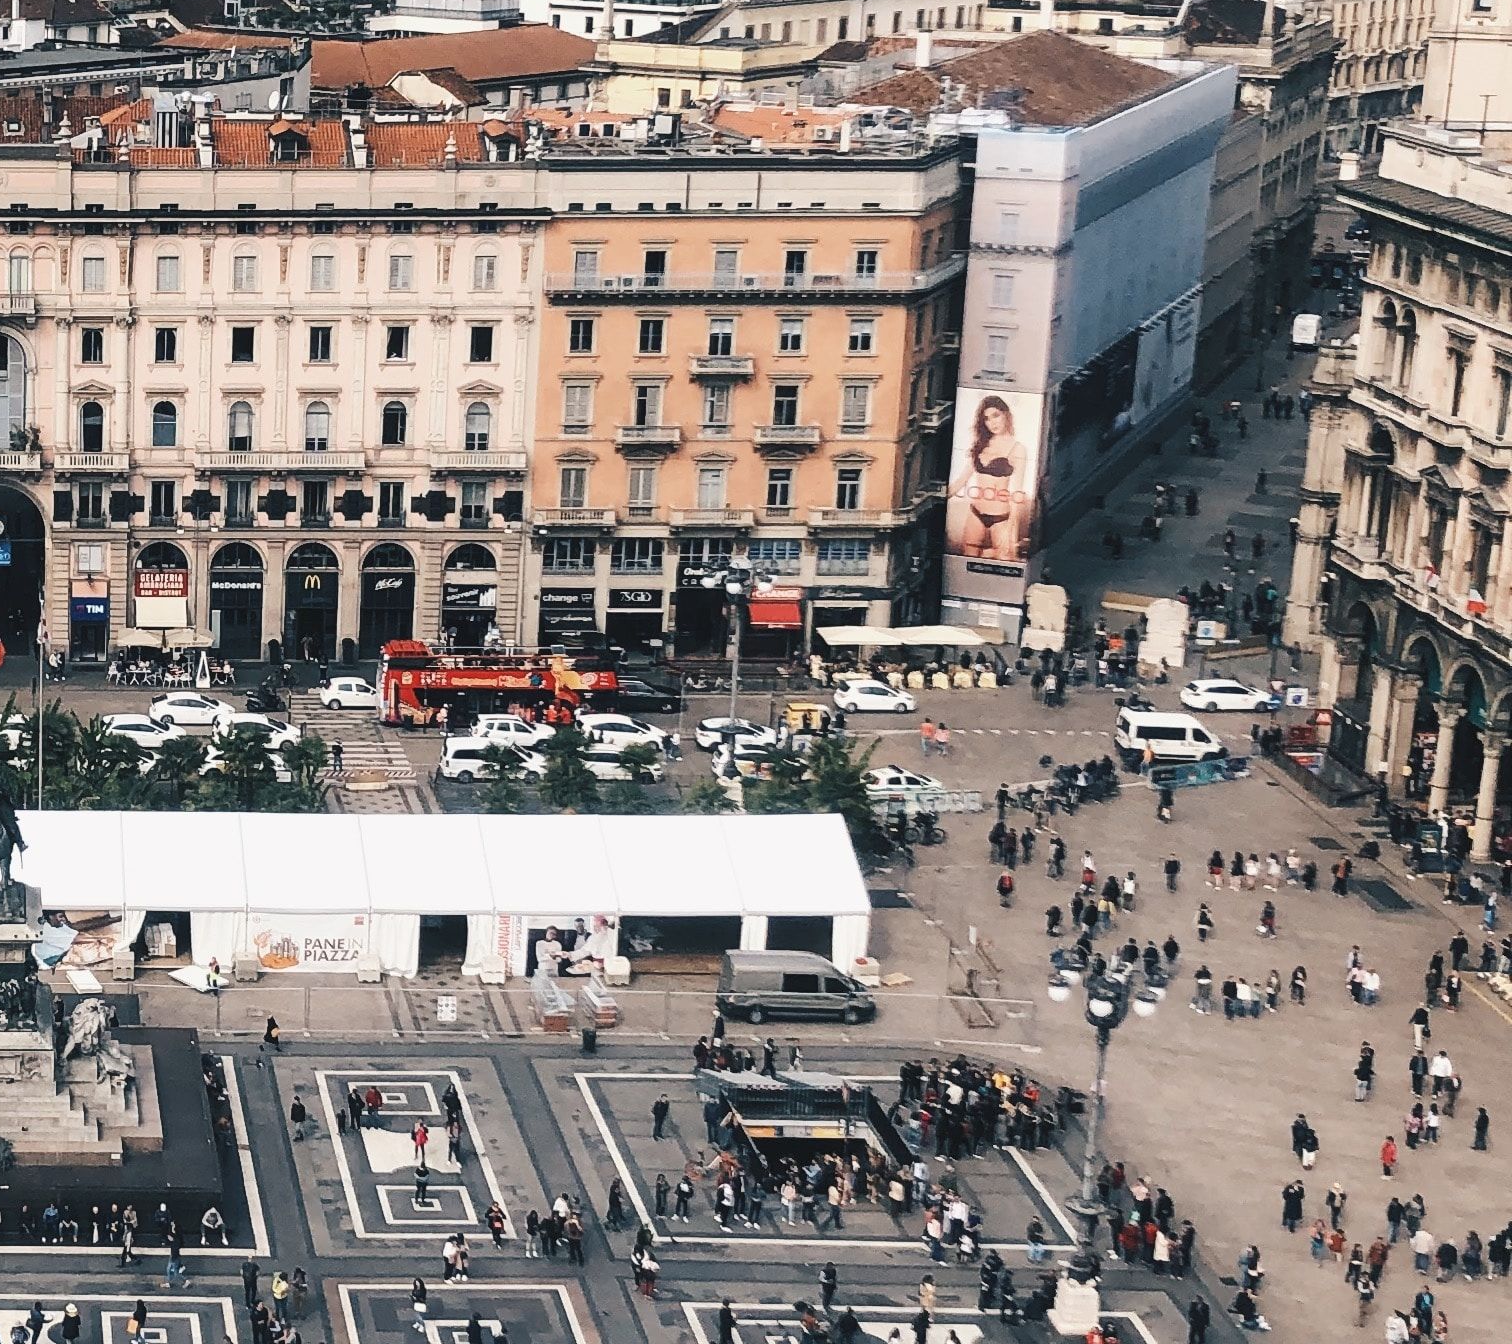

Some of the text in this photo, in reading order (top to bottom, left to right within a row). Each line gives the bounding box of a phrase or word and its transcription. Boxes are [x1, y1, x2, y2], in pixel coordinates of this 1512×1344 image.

[140, 573, 184, 582] GELATERIA
[211, 581, 262, 589] McDonald's
[542, 593, 579, 604] change
[85, 604, 104, 614] TIM
[304, 937, 363, 950] PANE IN
